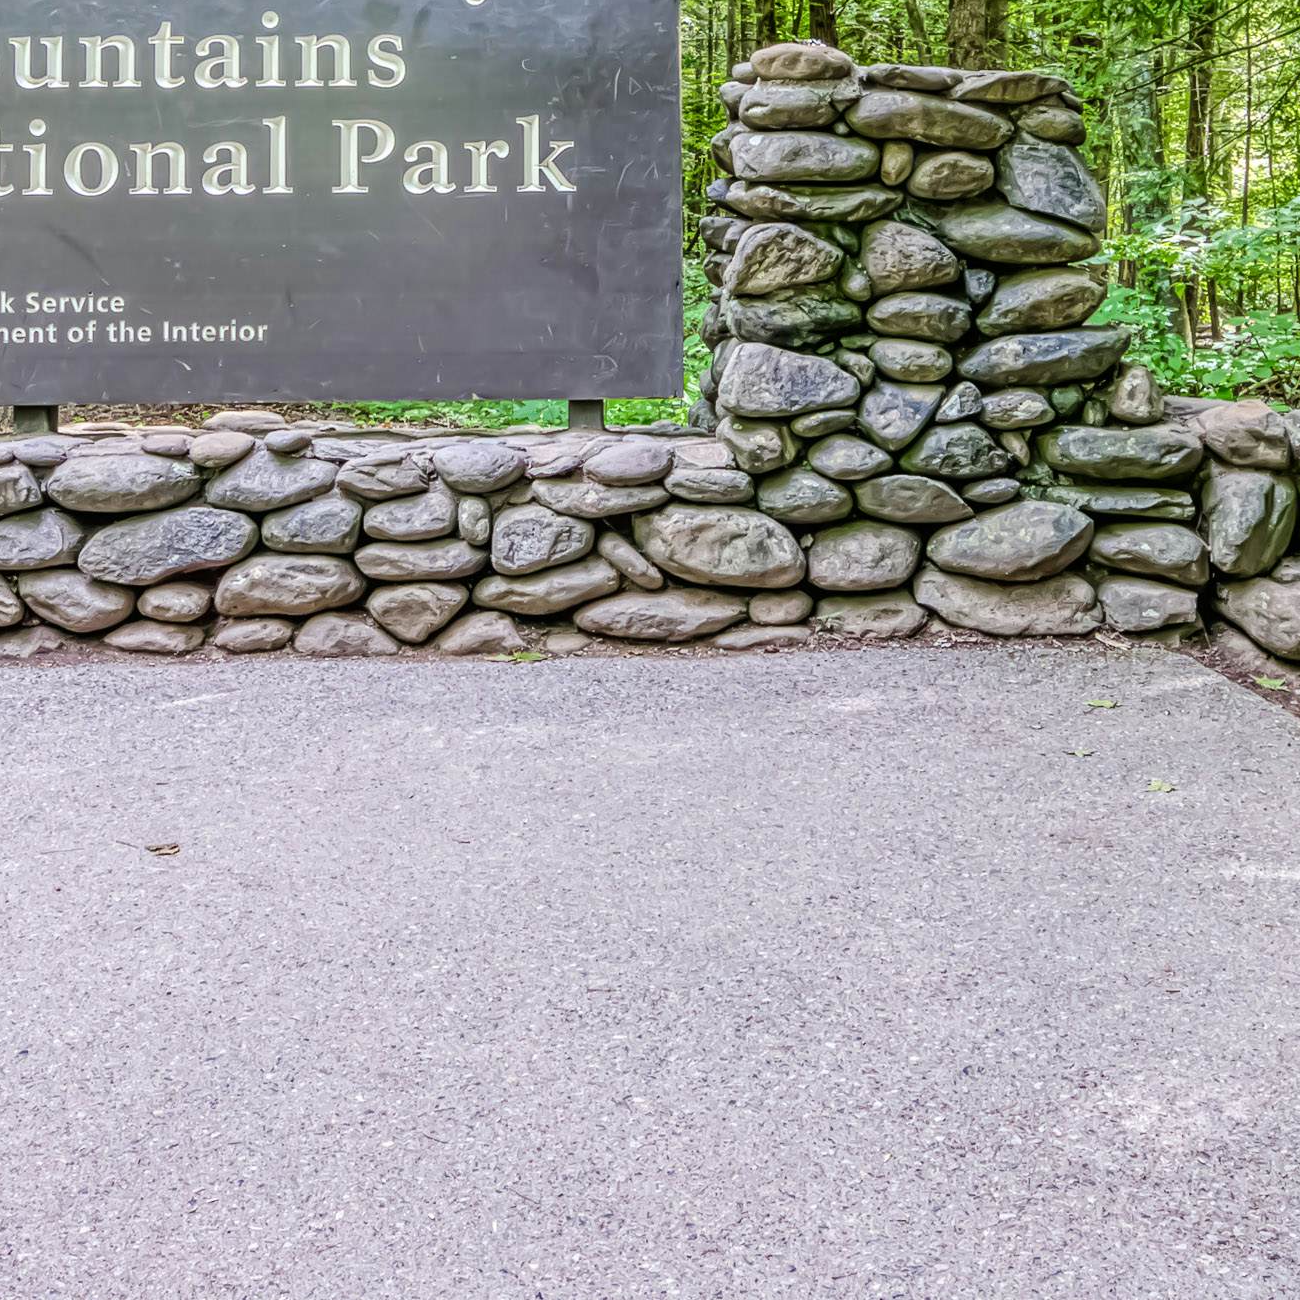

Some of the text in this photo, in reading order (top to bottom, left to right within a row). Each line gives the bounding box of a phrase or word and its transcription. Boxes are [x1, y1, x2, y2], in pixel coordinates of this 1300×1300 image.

[330, 113, 578, 195] Park
[25, 291, 126, 314] Service
[67, 319, 98, 343] of
[105, 320, 153, 343] the
[163, 318, 269, 343] Interior
